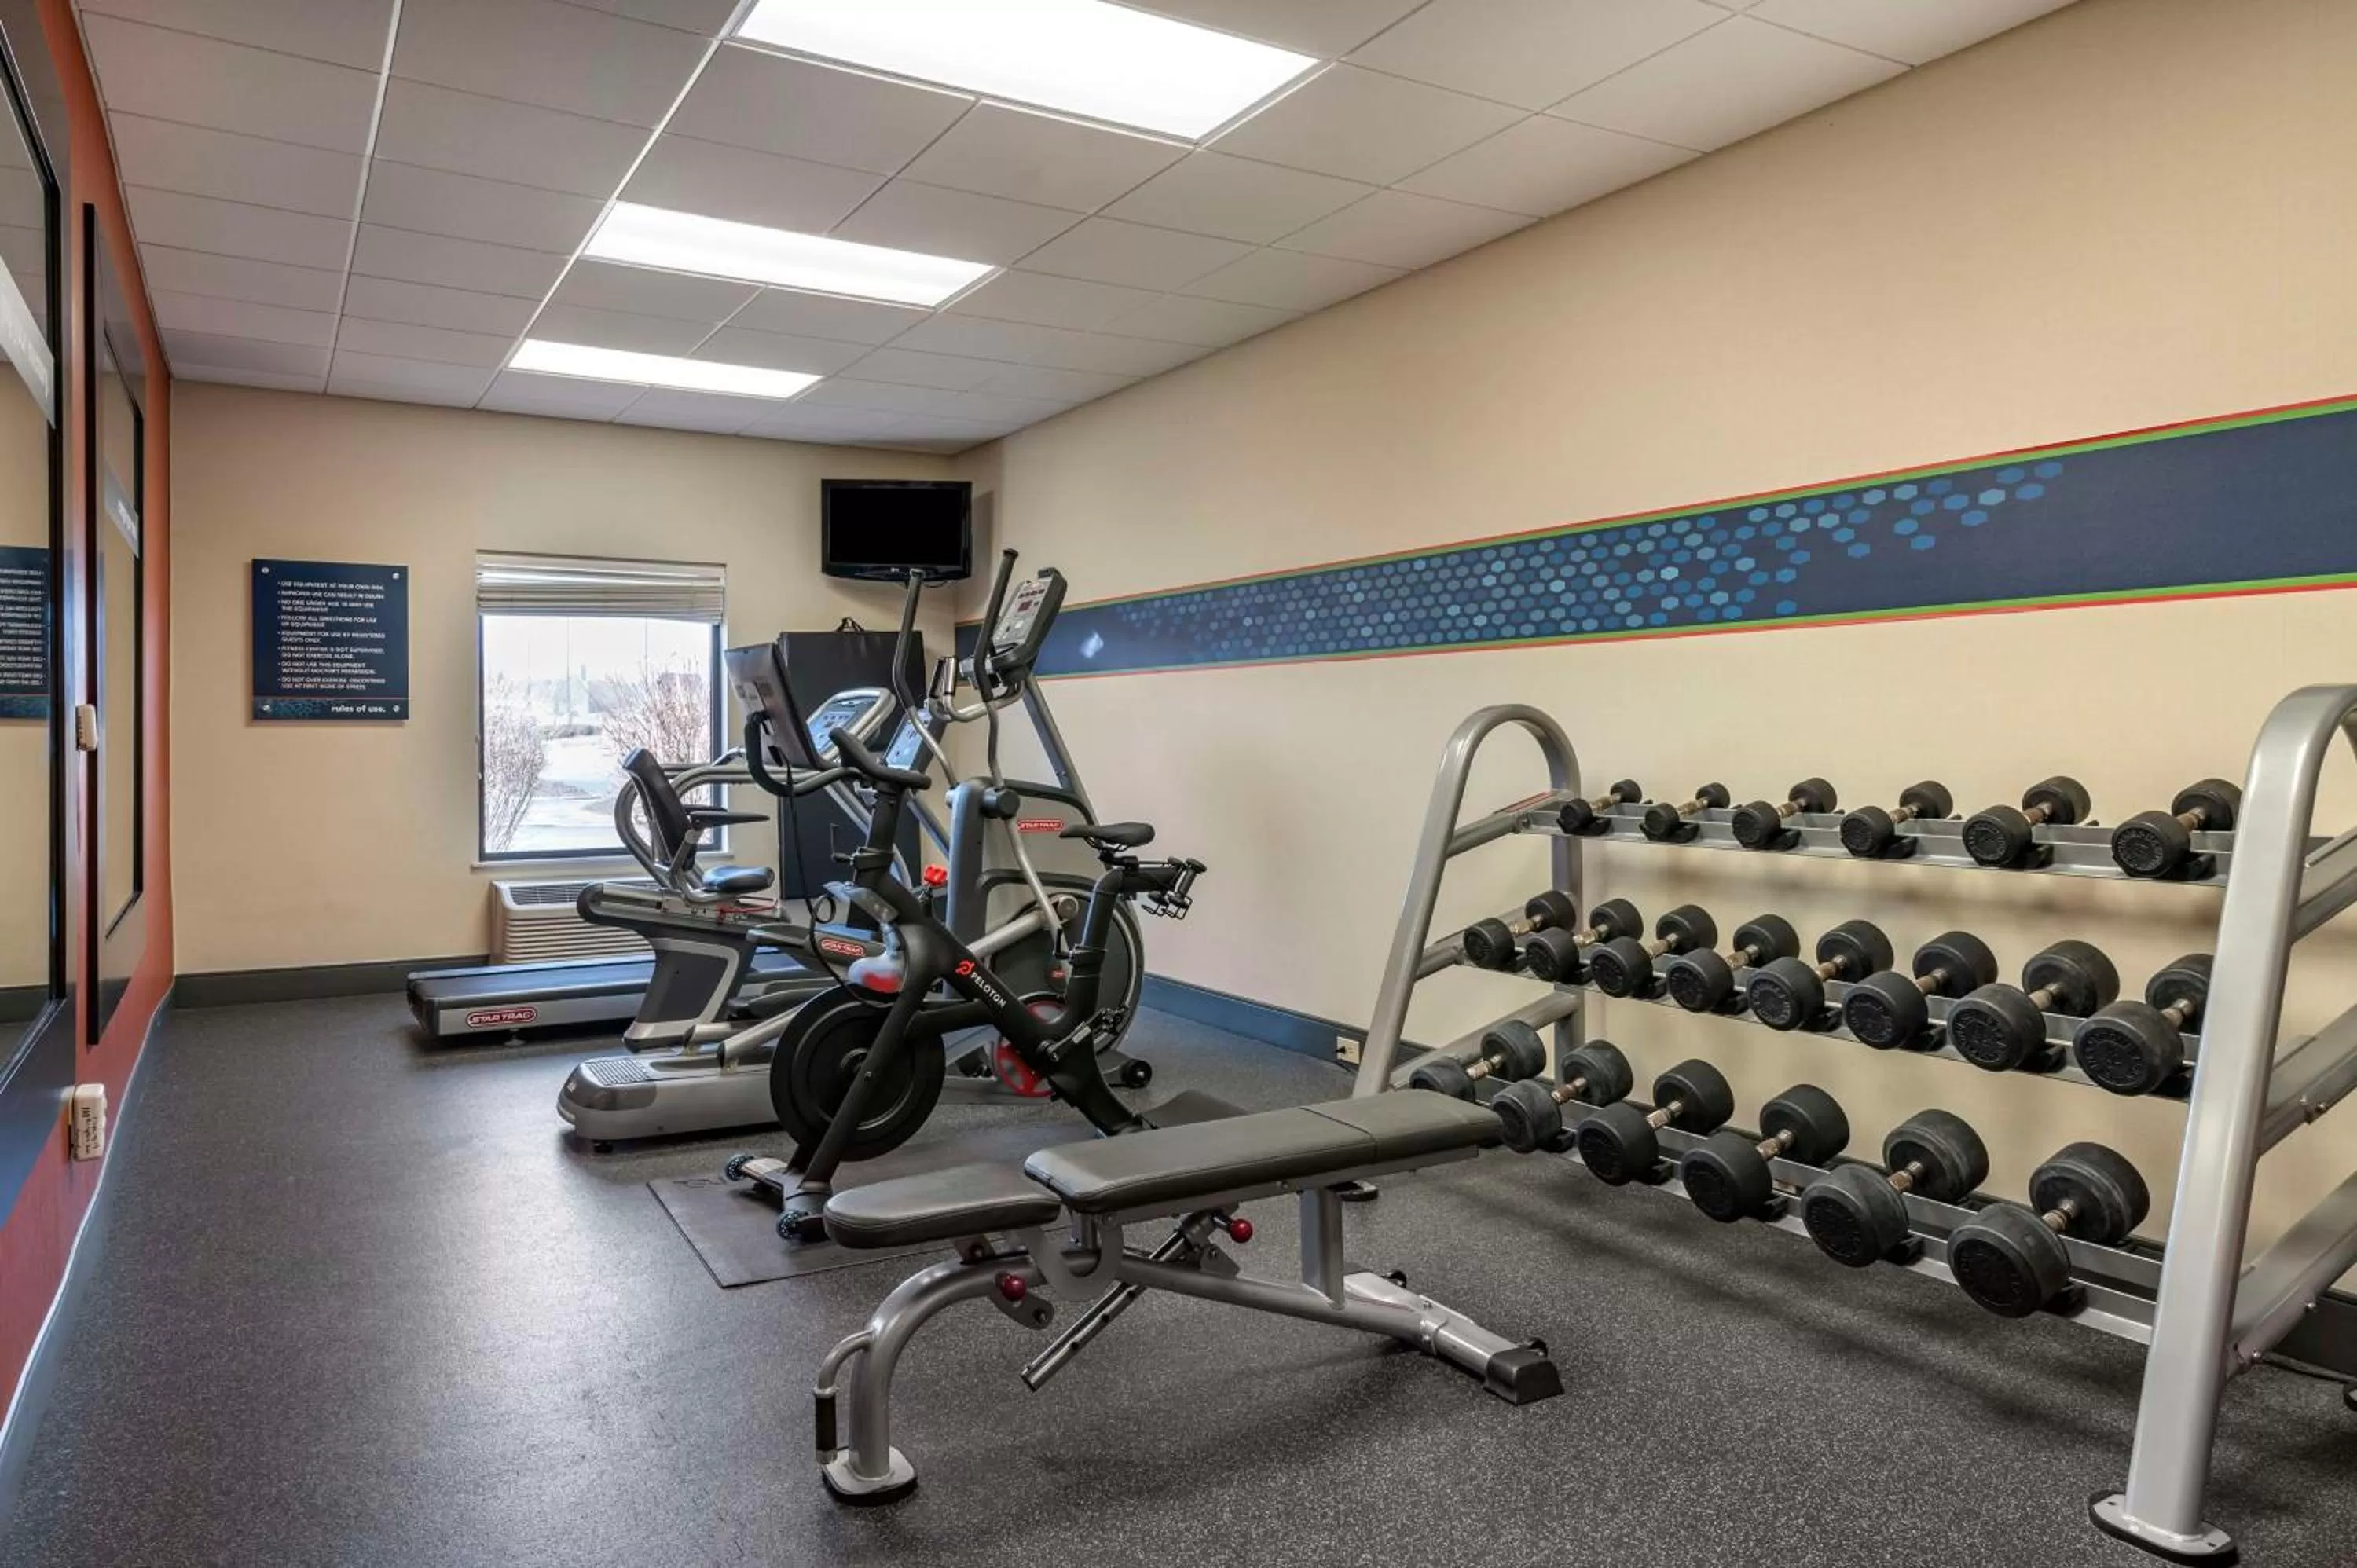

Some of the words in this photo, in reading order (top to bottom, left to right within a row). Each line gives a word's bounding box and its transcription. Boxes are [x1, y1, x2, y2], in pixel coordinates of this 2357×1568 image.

[971, 972, 1006, 1009] PELOTON
[471, 1013, 501, 1023] STAR
[500, 1011, 533, 1020] TRAC
